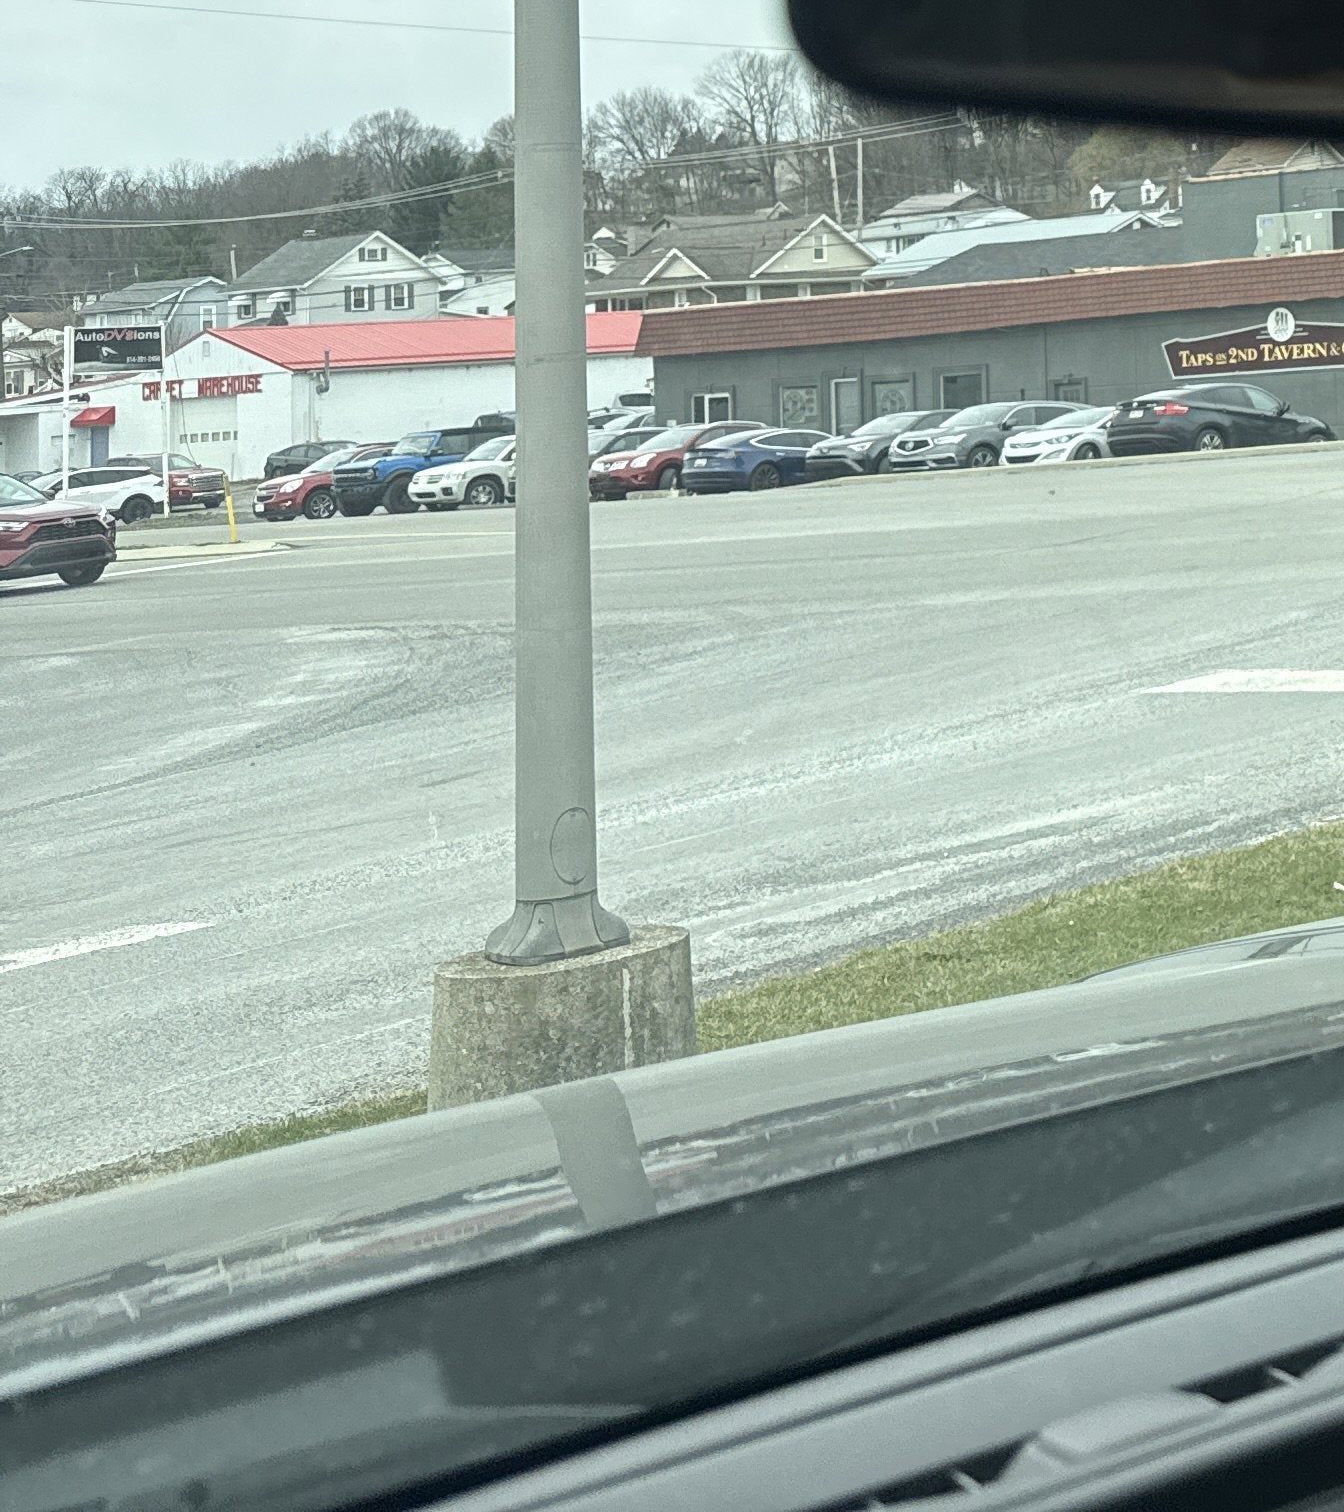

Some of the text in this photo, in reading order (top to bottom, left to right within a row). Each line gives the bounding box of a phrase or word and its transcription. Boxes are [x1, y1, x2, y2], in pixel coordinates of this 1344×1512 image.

[1228, 347, 1258, 364] 2ND
[1260, 342, 1328, 362] TAVERN
[1329, 342, 1341, 356] &
[198, 374, 263, 397] WAREHOUSE
